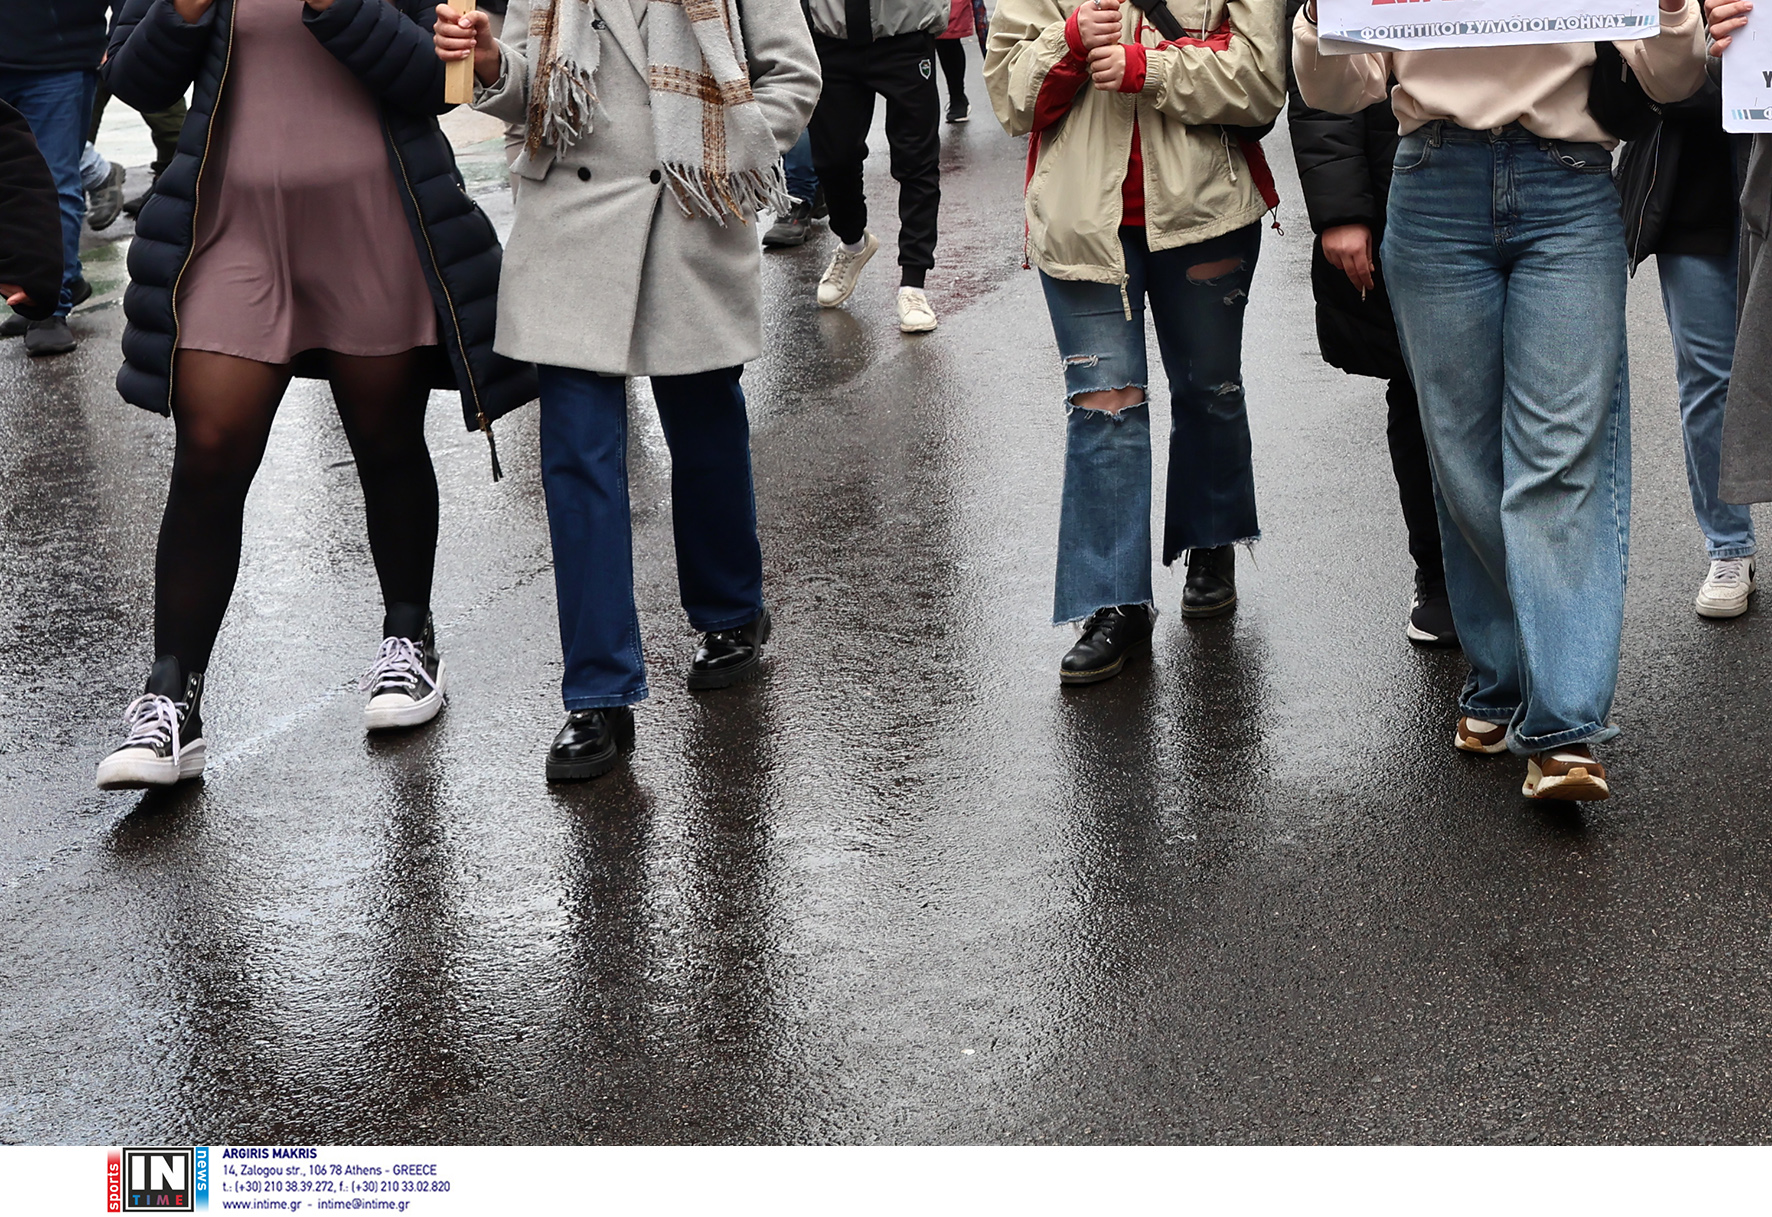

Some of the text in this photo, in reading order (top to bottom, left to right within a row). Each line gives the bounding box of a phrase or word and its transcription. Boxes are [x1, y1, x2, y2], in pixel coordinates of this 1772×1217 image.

[1361, 14, 1626, 40] ΦΟΙΤΗΤΙΚΟΙ ΣΥΛΛΟΓΟΙ ΑΘΗΝΑΣ
